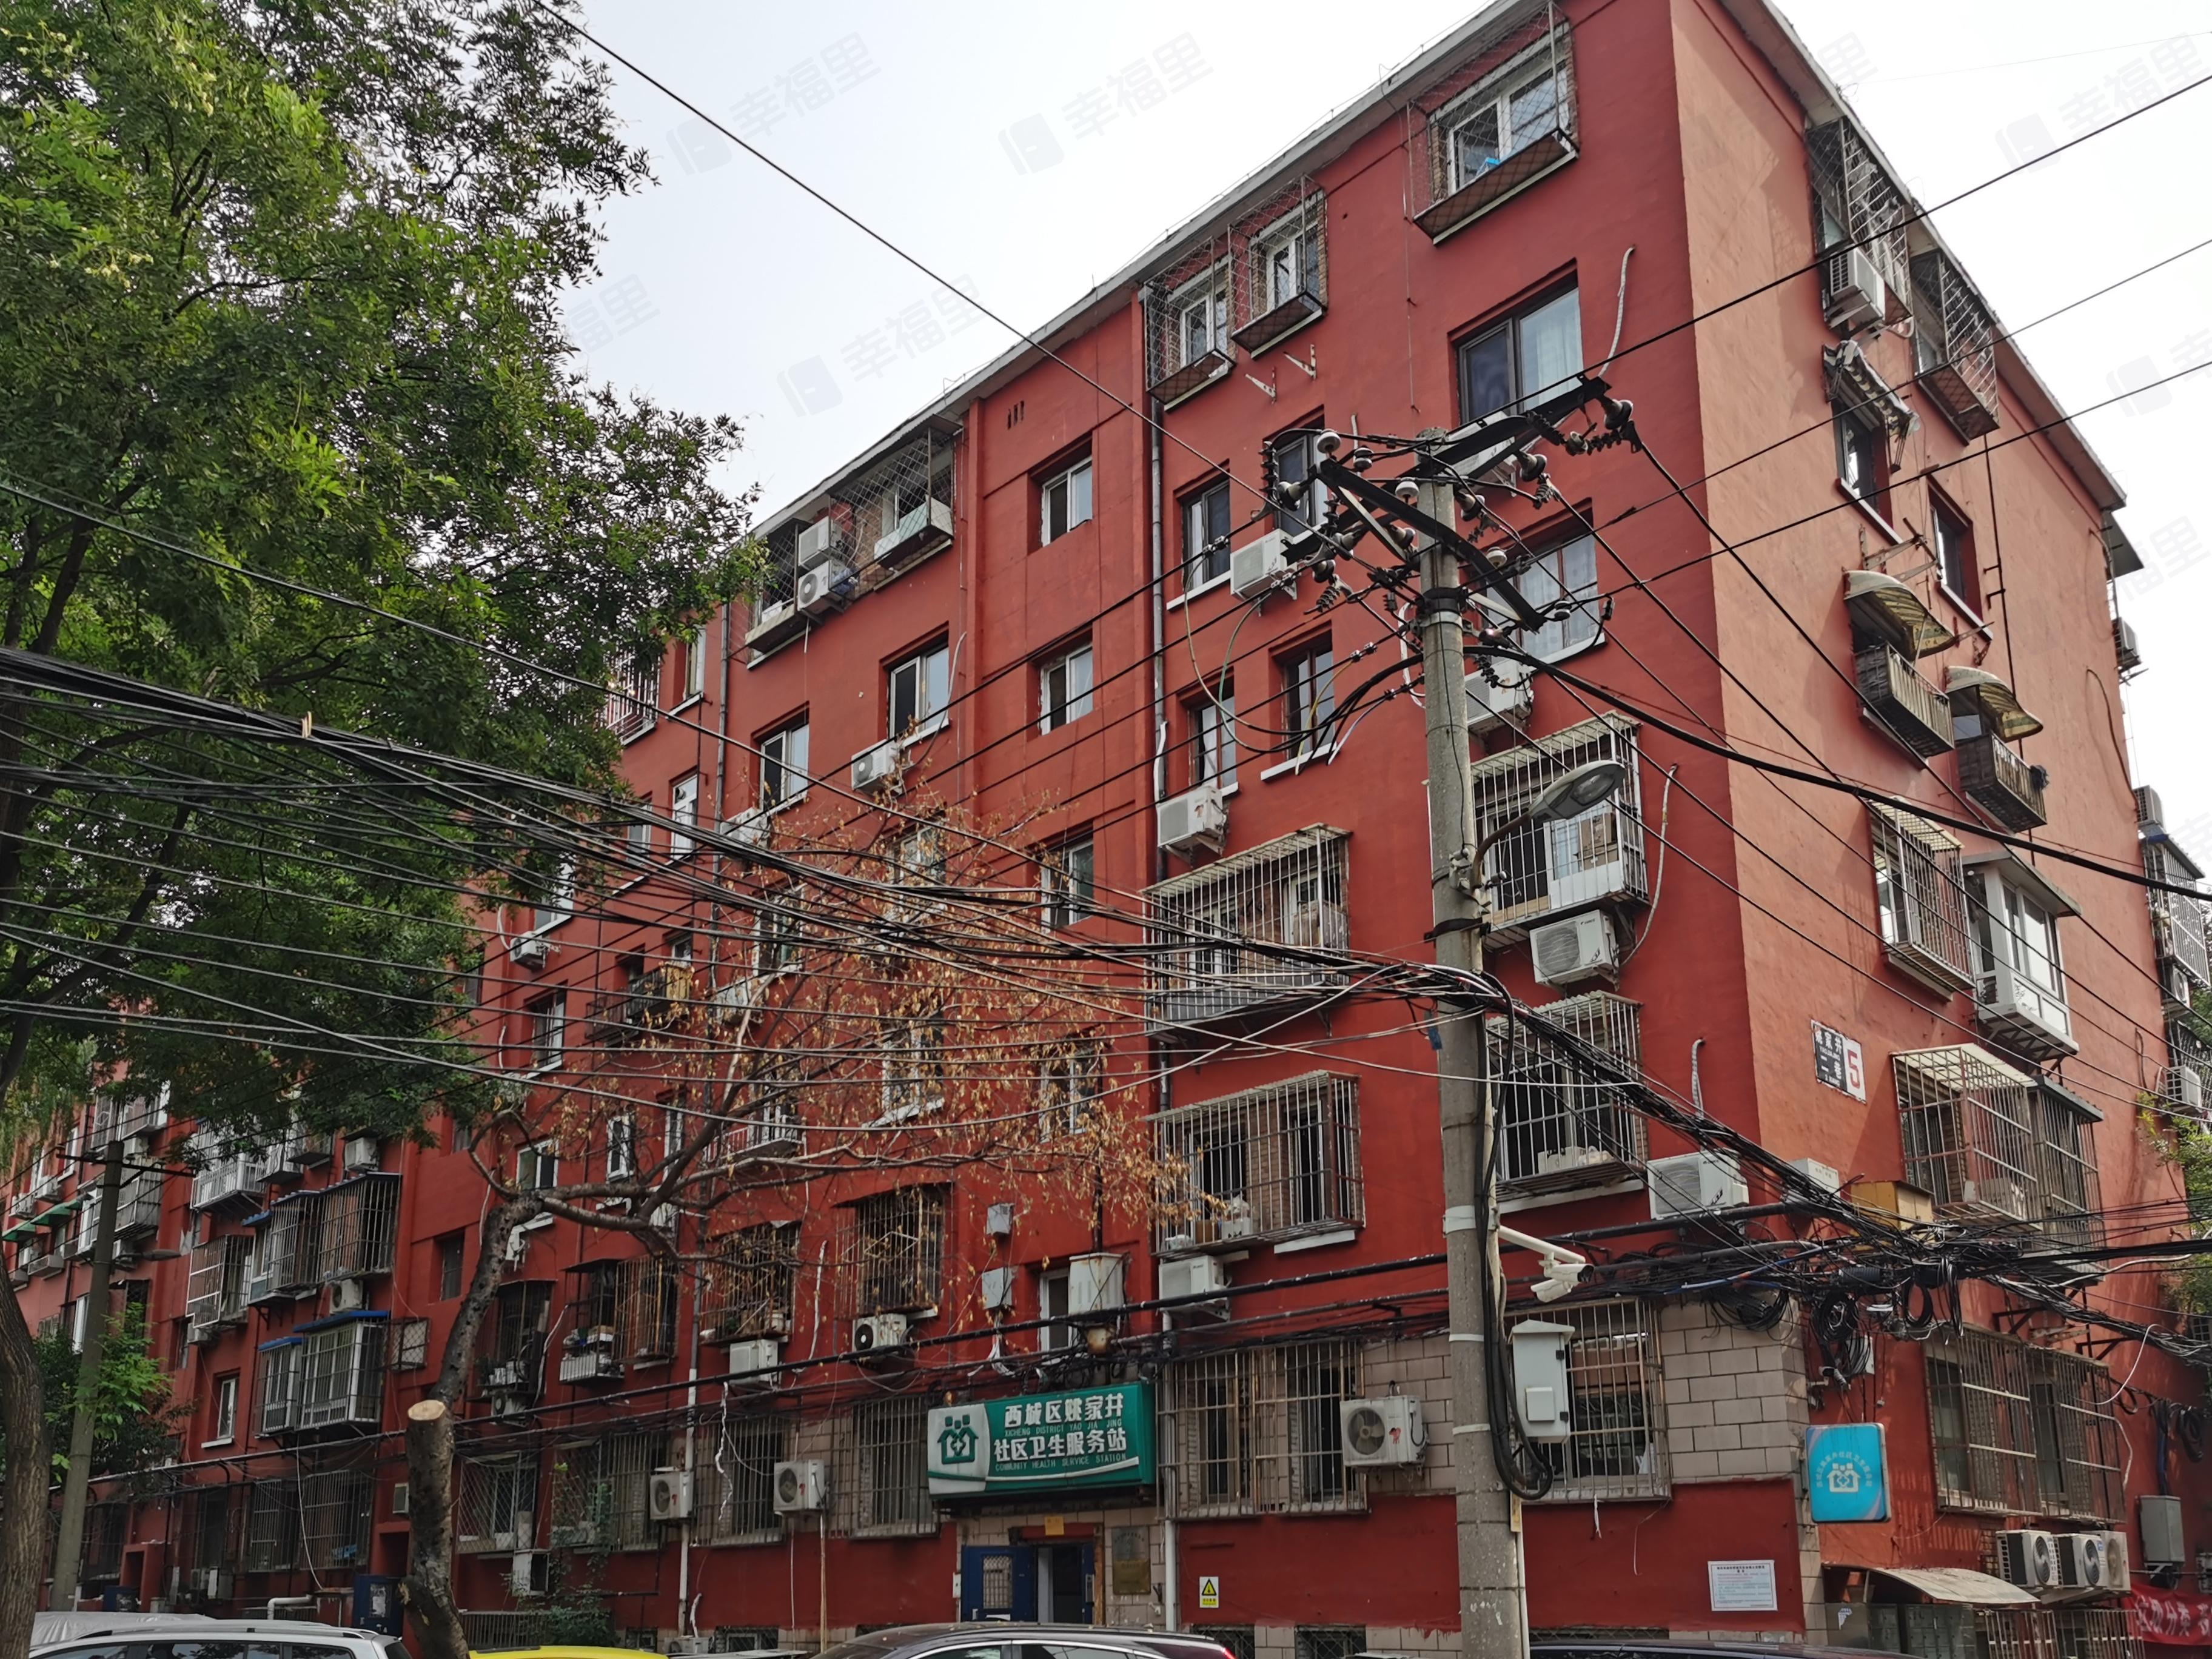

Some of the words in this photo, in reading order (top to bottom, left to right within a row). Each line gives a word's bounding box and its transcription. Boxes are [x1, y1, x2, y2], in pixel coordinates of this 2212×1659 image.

[1847, 1048, 1860, 1090] 5
[1004, 1392, 1124, 1428] 西城区姚家井
[1004, 1427, 1031, 1437] XICHENG
[1036, 1424, 1064, 1435] DISTRICT
[1070, 1423, 1082, 1431] YAO
[1087, 1421, 1098, 1430] JIA
[1106, 1418, 1122, 1428] JING
[994, 1427, 1127, 1462] 社区卫生服务站
[1032, 1458, 1056, 1469] HEALTH
[1062, 1456, 1090, 1467] SERVICE
[1096, 1452, 1127, 1464] STATION
